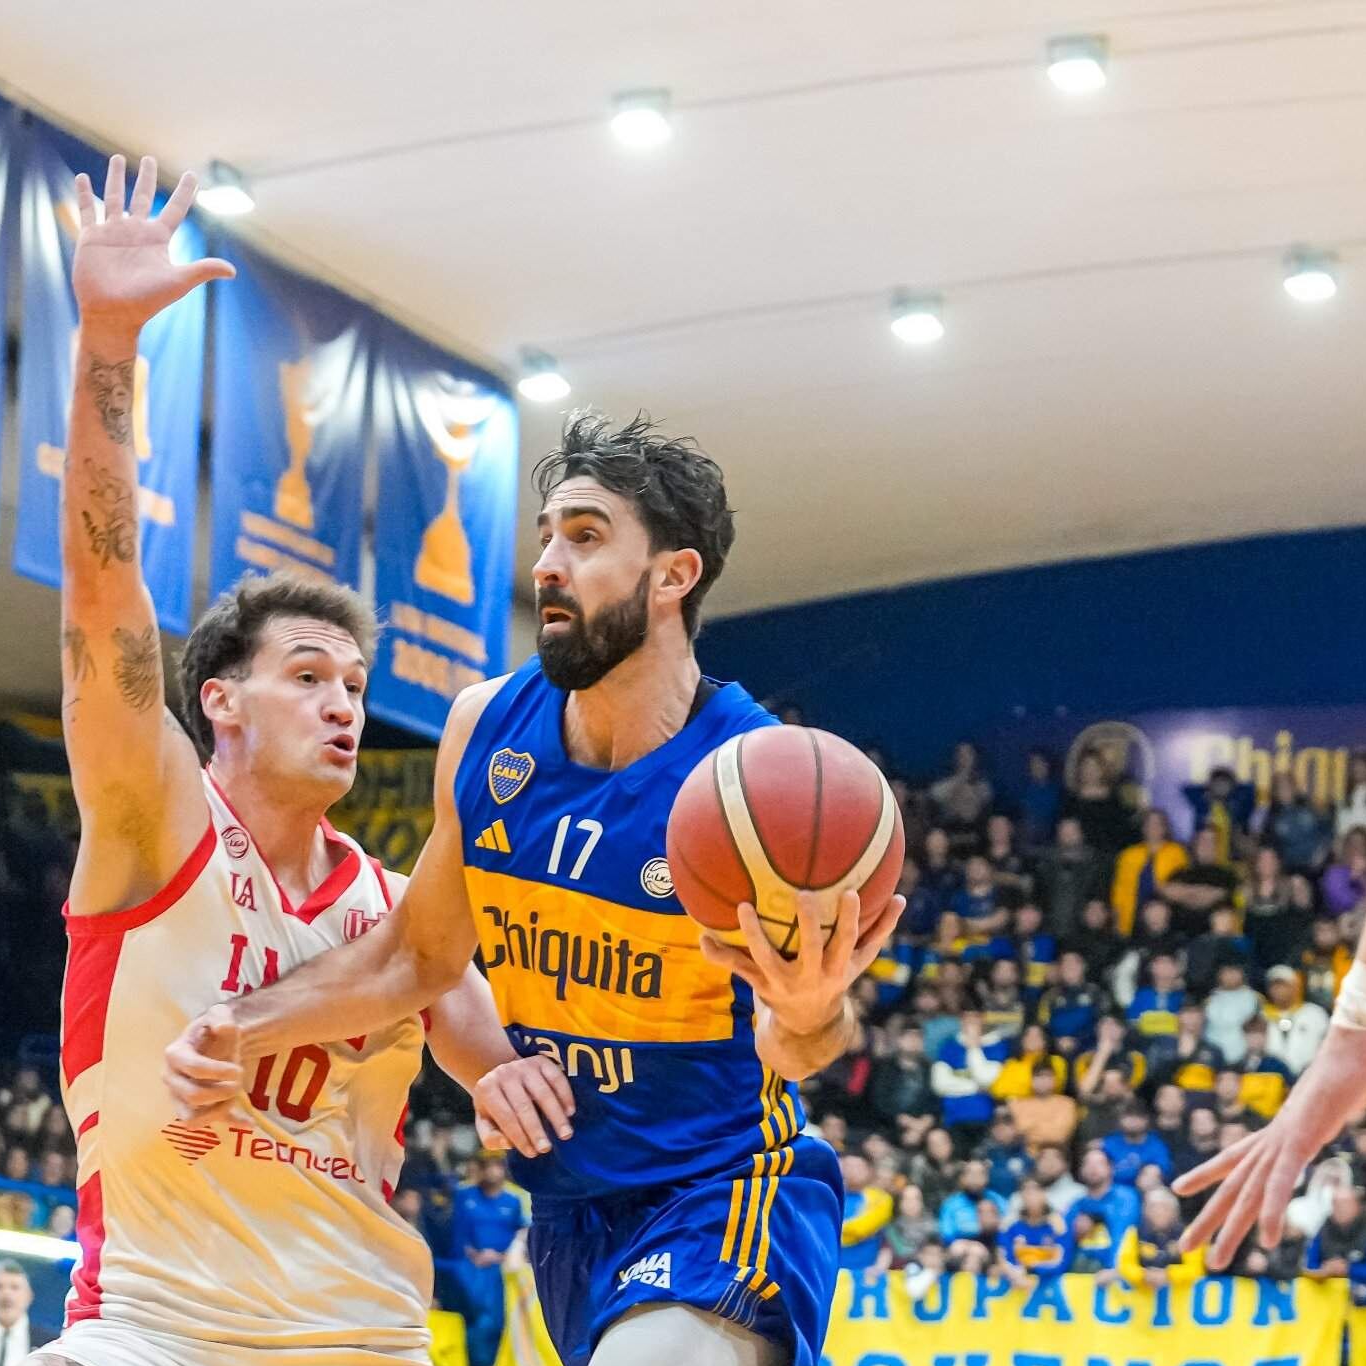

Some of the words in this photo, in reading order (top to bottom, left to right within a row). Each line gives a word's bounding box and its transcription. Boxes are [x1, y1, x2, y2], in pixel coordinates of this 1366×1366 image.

[547, 814, 604, 881] 17
[483, 905, 663, 1001] Chiquita
[247, 1043, 332, 1123] 10
